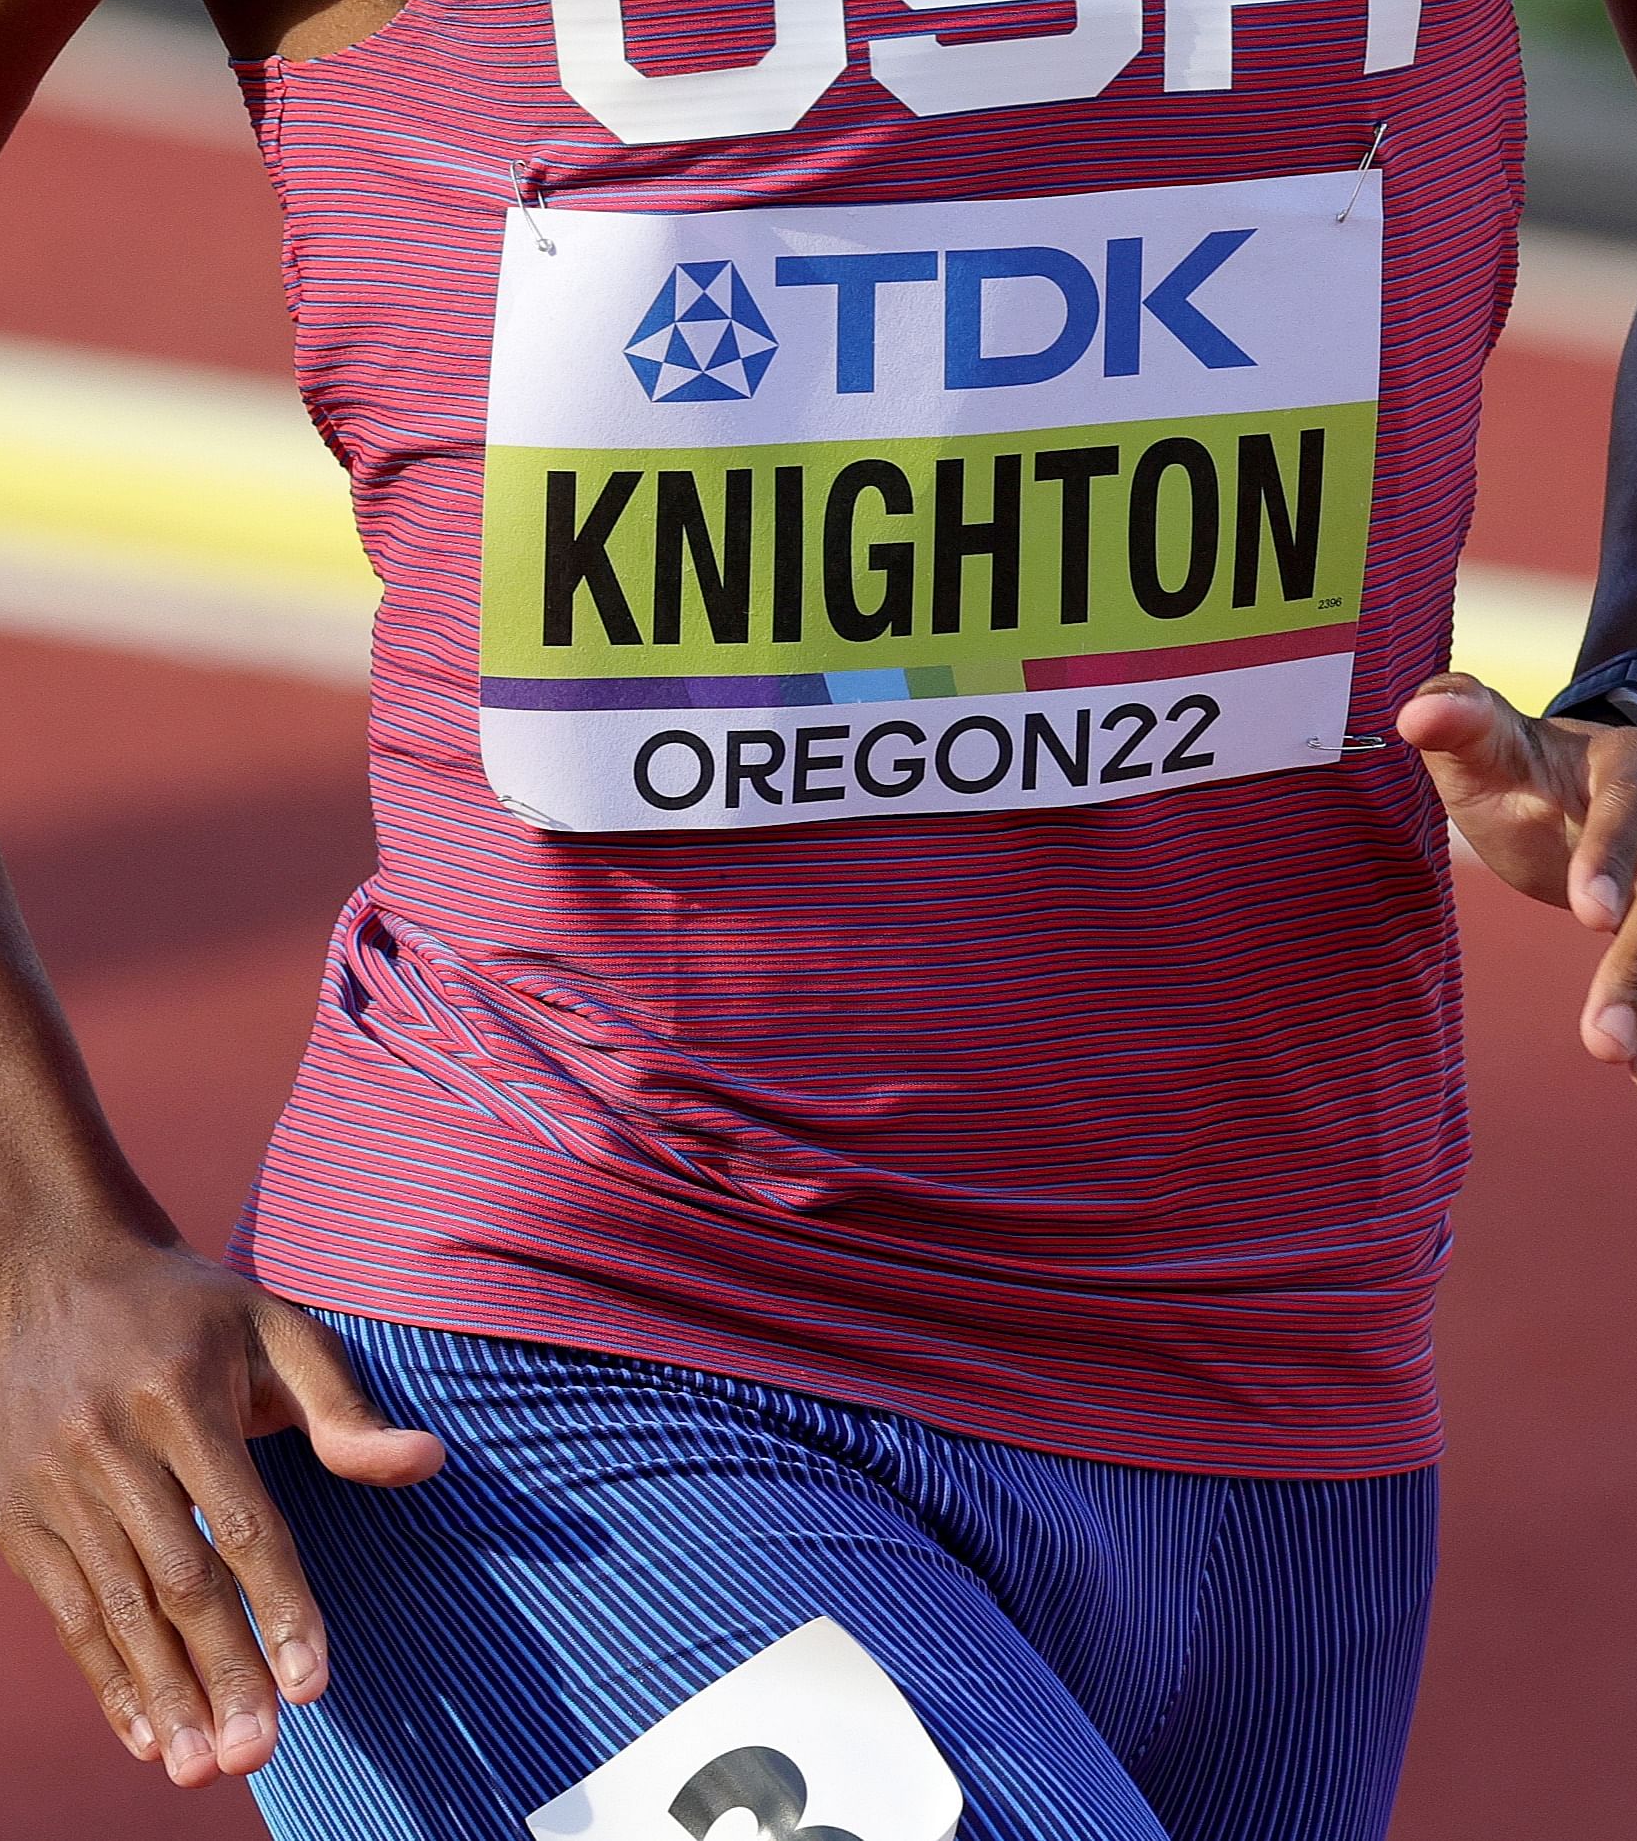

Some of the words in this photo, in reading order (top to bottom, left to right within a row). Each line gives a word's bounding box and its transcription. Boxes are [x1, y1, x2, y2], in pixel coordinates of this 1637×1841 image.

[775, 228, 1258, 394] TDK
[542, 428, 1325, 648] KNIGHTON
[1317, 596, 1343, 610] 2396
[633, 694, 1221, 811] OREGON22
